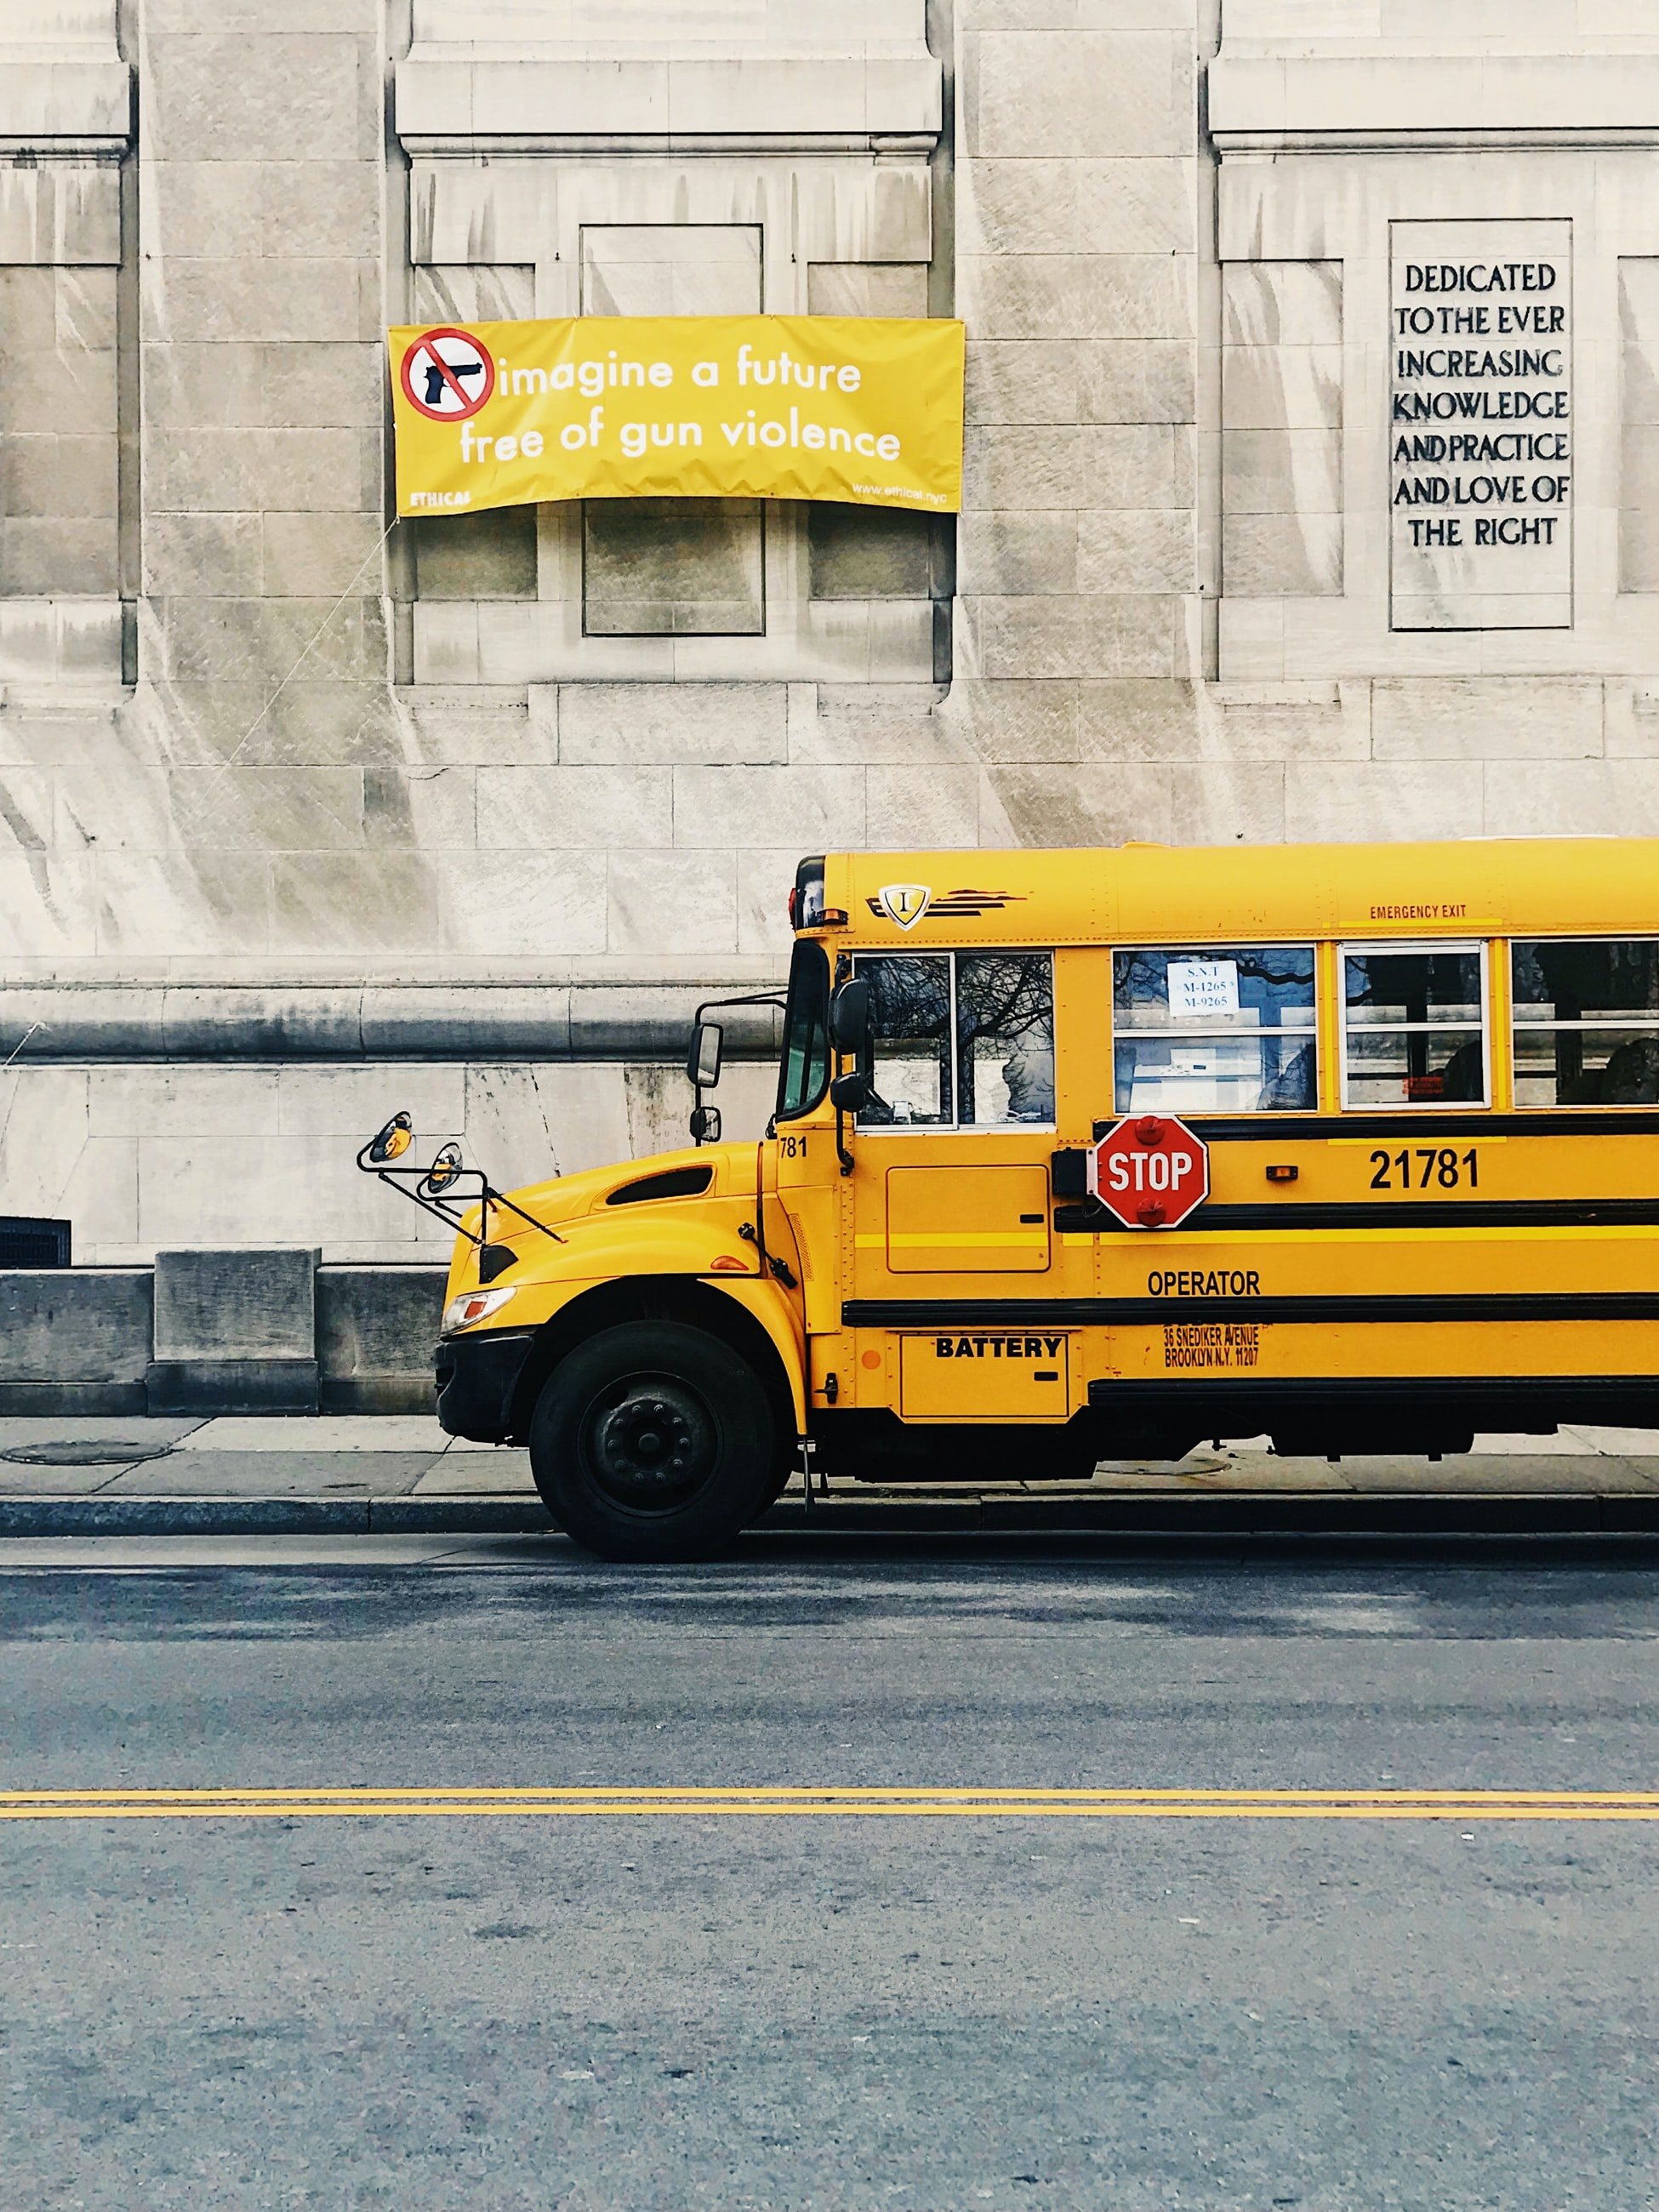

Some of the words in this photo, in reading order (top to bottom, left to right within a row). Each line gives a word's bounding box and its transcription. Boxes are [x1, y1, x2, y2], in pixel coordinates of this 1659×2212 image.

[1405, 264, 1556, 292] DEDICATED
[1394, 307, 1434, 334] TO
[1436, 307, 1490, 334] THE
[1498, 306, 1565, 334] EVER
[499, 350, 672, 400] imagine
[692, 362, 718, 387] a
[738, 345, 861, 391] future
[1398, 350, 1563, 378] INCREASING
[1393, 391, 1569, 419] KNOWLEDGE
[460, 421, 544, 463] free
[560, 407, 604, 448] of
[621, 421, 702, 457] gun
[721, 408, 901, 460] violence
[1394, 435, 1446, 462] AND
[1449, 433, 1570, 461] PRACTICE
[410, 491, 471, 507] ETHICAL
[852, 482, 947, 505] www.ethical.nyc
[1394, 477, 1448, 505] AND
[1454, 476, 1526, 504] LOVE
[1532, 476, 1571, 502] OF
[1408, 519, 1462, 546] THE
[1475, 517, 1558, 545] RIGHT
[1371, 905, 1438, 919] EMERGENCY
[1442, 904, 1466, 918] EXIT
[1184, 981, 1226, 992] M-1265
[1185, 996, 1228, 1006] M-9265
[780, 1136, 807, 1159] 781
[1109, 1152, 1192, 1191] STOP
[1370, 1149, 1478, 1189] 21781
[1148, 1270, 1260, 1296] OPERATOR
[936, 1337, 1063, 1358] BATTERY
[1164, 1327, 1174, 1347] 36
[1177, 1327, 1222, 1347] SNEDIKER
[1225, 1326, 1259, 1346] AVENUE
[1166, 1348, 1212, 1367] BROOKLYN
[1236, 1348, 1258, 1366] 11207
